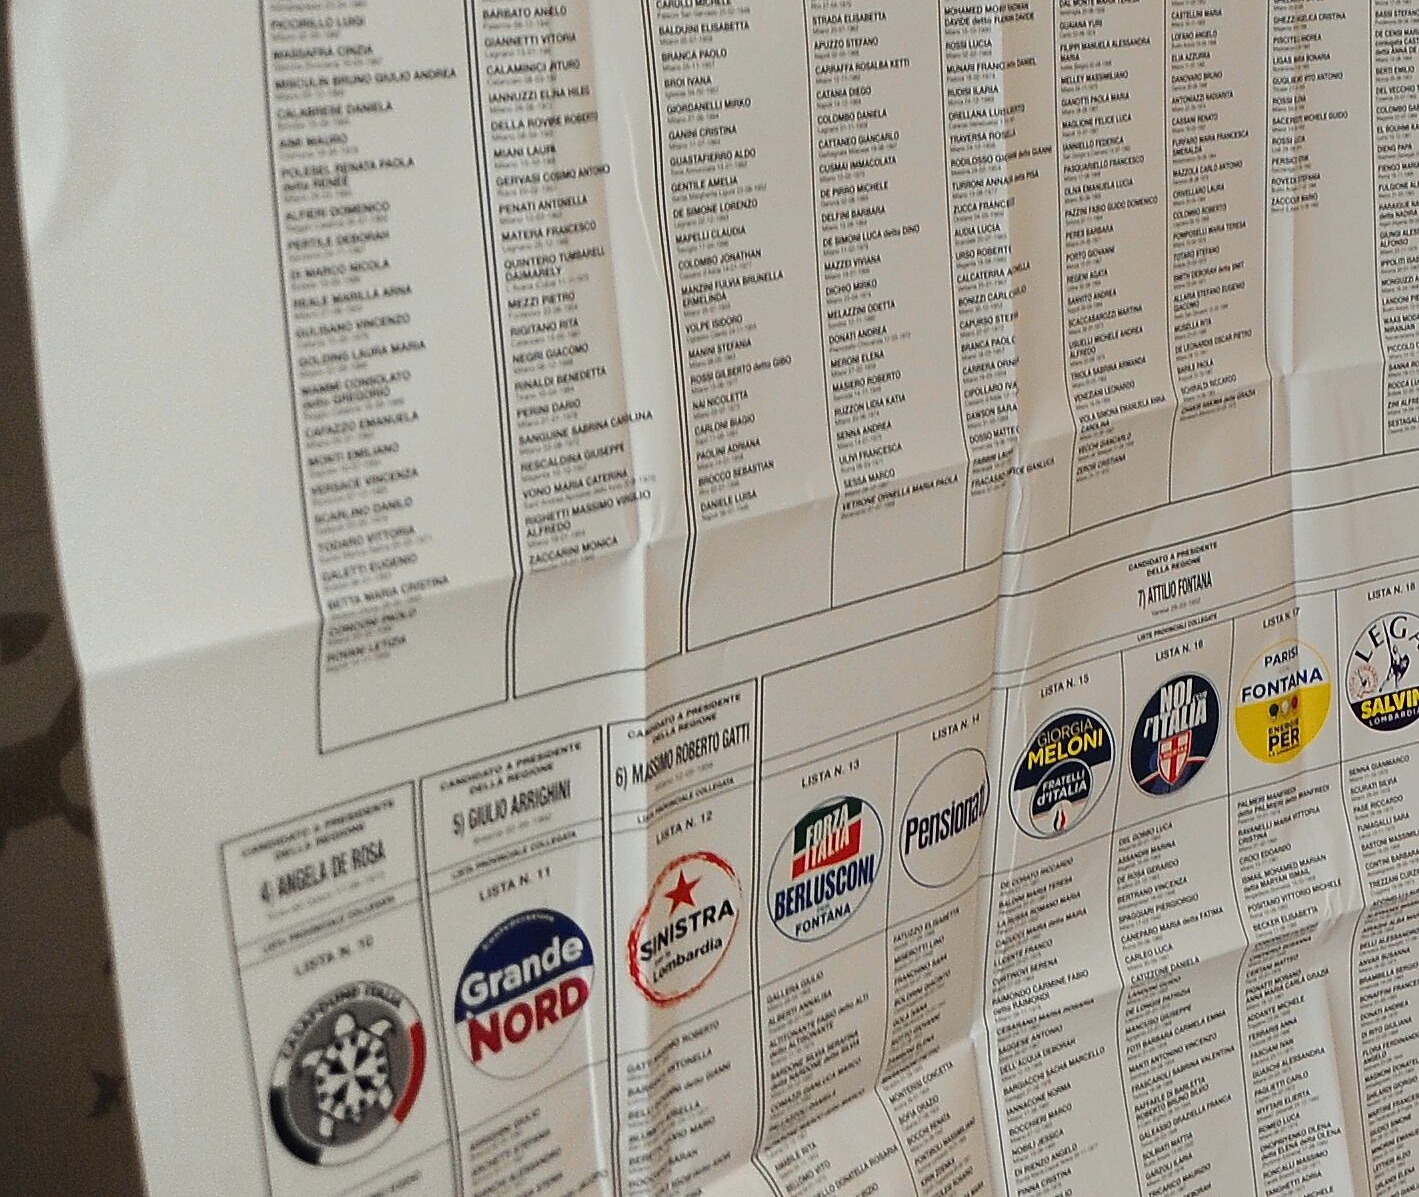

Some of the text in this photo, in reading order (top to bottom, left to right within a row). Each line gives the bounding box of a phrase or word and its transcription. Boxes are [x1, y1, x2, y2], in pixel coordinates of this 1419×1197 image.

[1148, 578, 1178, 603] ATTILIO
[1179, 570, 1213, 597] FONTANA
[1367, 582, 1415, 601] LISTA N. 18
[1264, 646, 1298, 667] PARISI
[1160, 678, 1193, 714] NOI
[1241, 666, 1323, 703] FONTANA
[1027, 728, 1103, 771] MELONI
[1037, 718, 1093, 748] GIORGIA
[1267, 727, 1300, 752] PER
[615, 766, 629, 791] 6)
[675, 731, 720, 770] ROBERTO
[722, 723, 750, 752] GATTI
[1037, 780, 1088, 807] d'ITALIA
[1042, 769, 1085, 792] FRATELLI
[806, 803, 849, 847] FORZA
[804, 825, 850, 871] ITALIA
[775, 854, 875, 922] BERLUSCONI
[640, 898, 734, 963] SINISTRA
[795, 902, 851, 936] FONTANA
[460, 934, 584, 1009] Grande
[652, 936, 723, 984] Lombardia
[466, 976, 590, 1065] NORD
